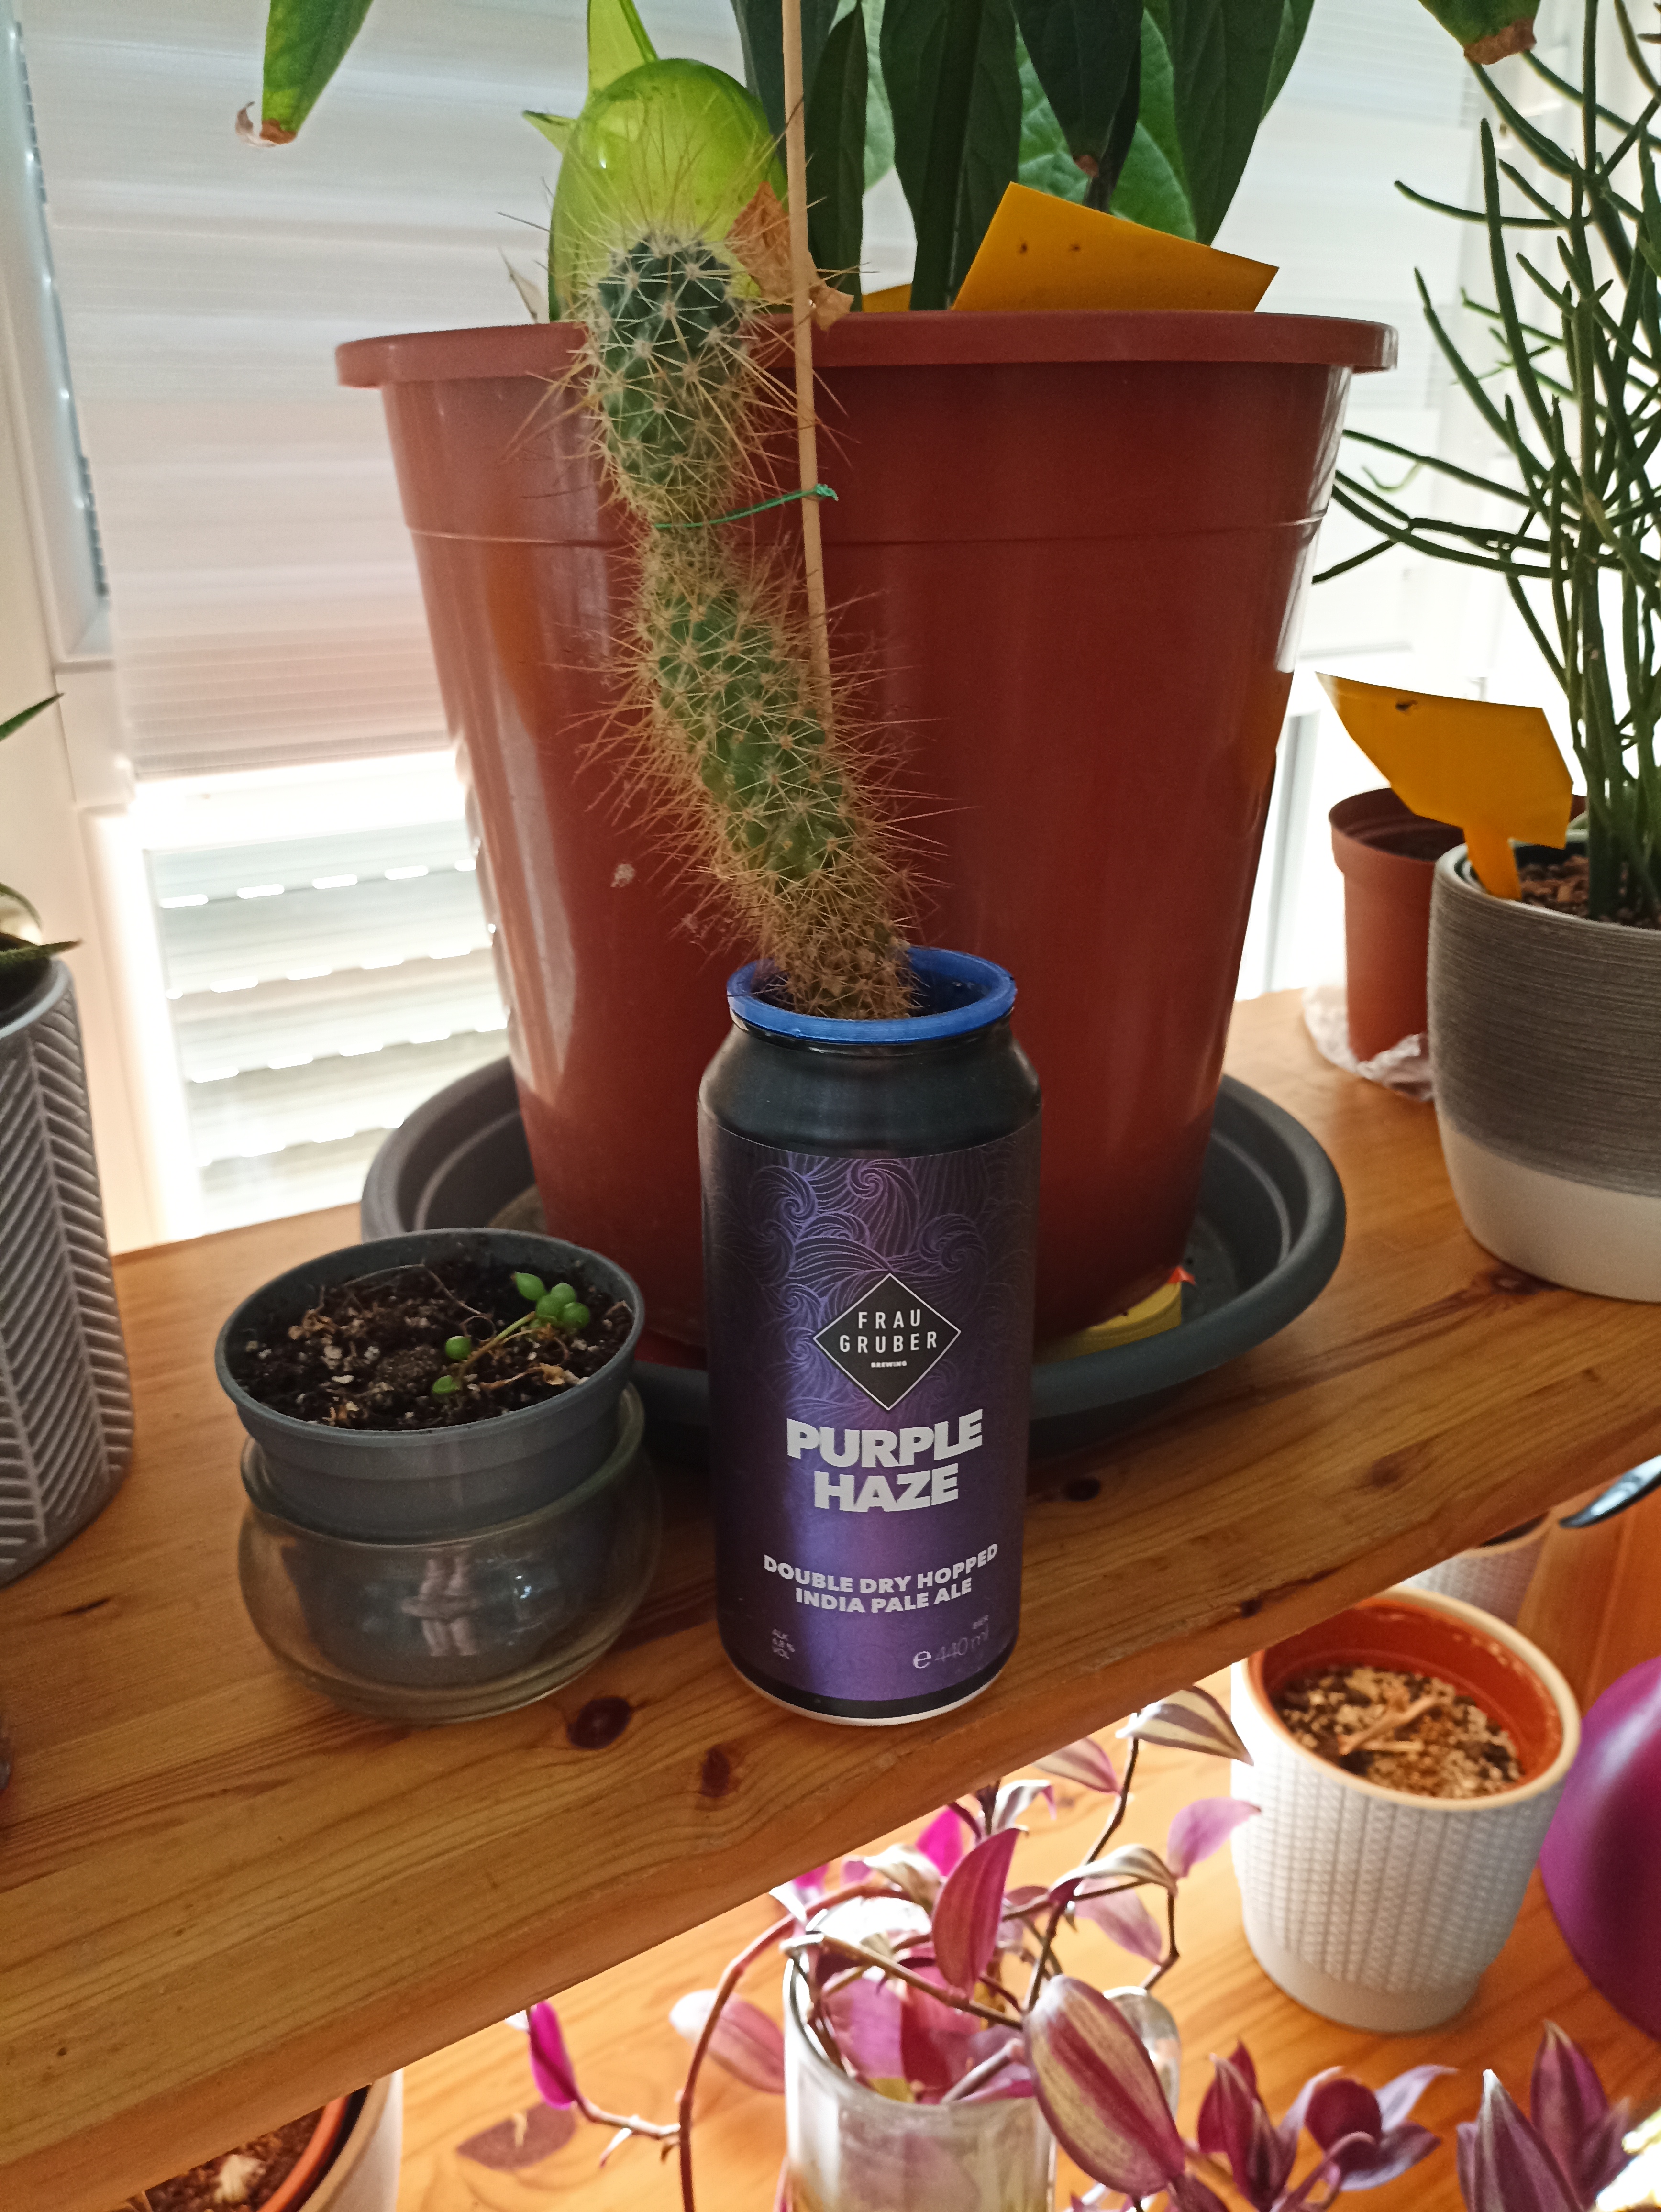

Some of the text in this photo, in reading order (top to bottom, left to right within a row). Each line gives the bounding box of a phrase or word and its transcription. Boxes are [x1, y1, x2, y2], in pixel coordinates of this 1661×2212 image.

[858, 1309, 920, 1329] FRAU
[840, 1331, 937, 1353] GRUBER
[786, 1408, 983, 1467] PURPLE
[814, 1462, 958, 1512] HAZE
[764, 1543, 998, 1593] DOUBLE DRY HOPPED
[796, 1577, 972, 1613] INDIA PALE ALE
